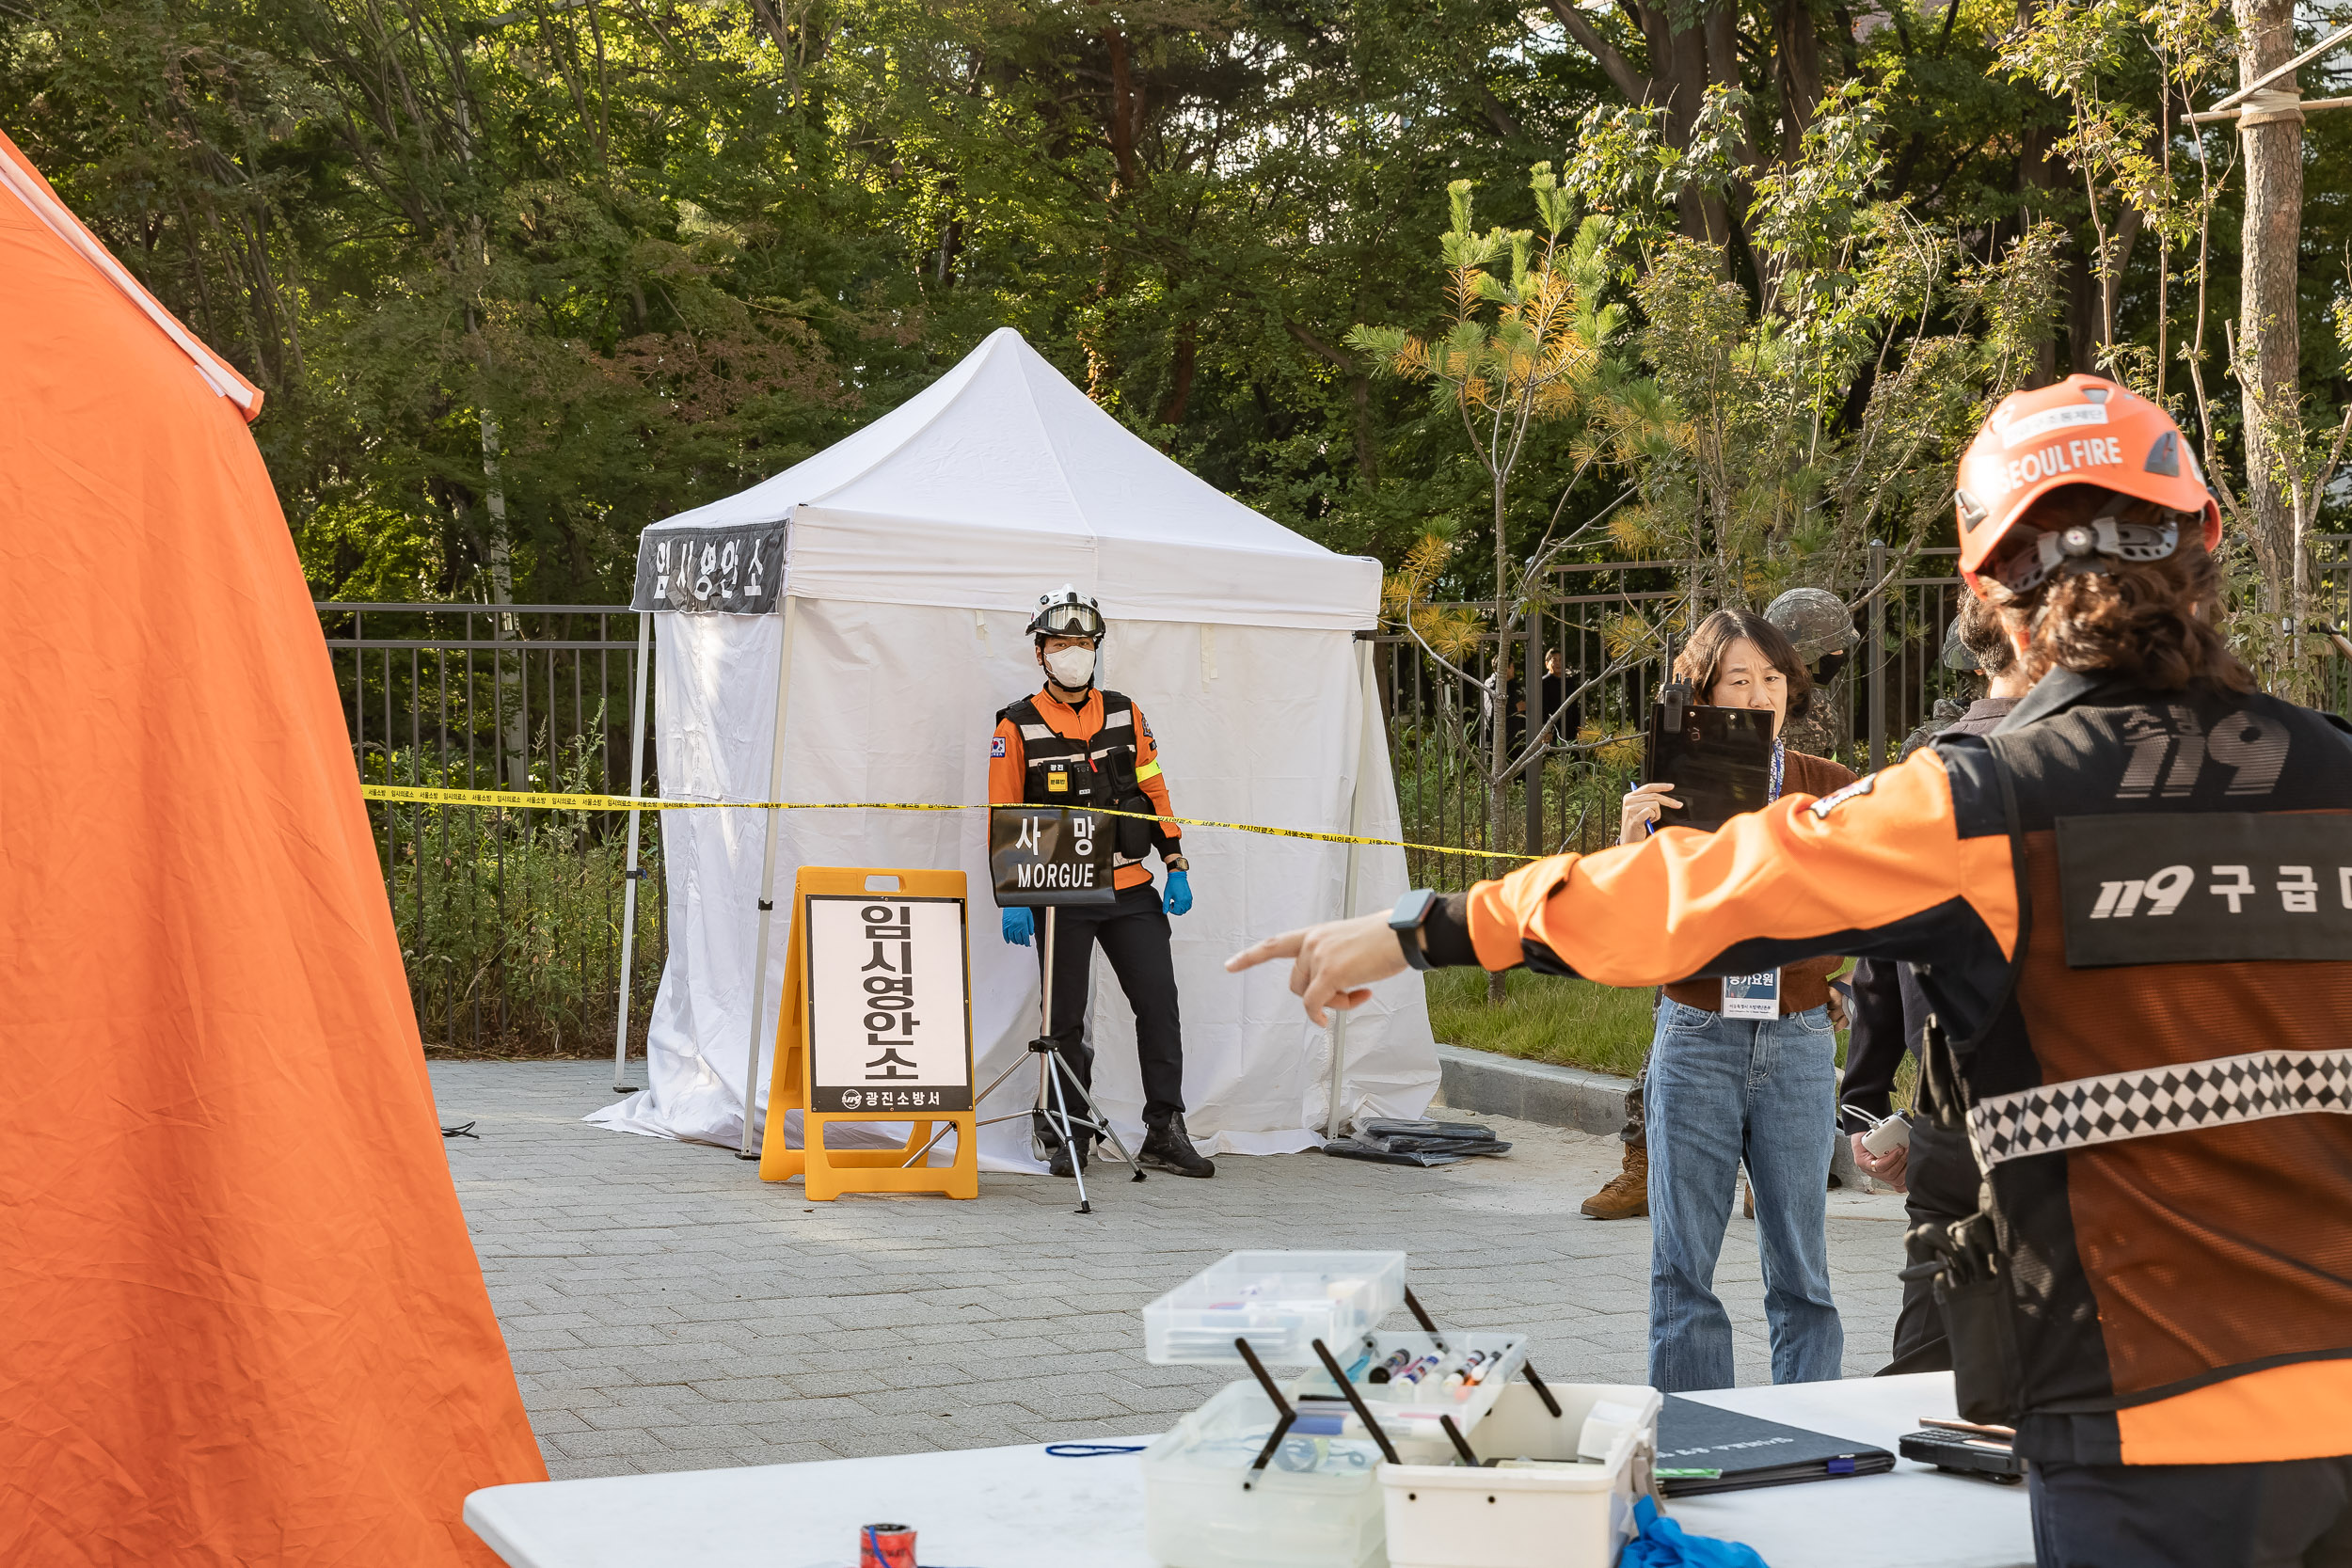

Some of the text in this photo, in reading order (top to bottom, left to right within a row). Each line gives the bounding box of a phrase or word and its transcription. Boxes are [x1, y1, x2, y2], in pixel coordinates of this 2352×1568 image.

[2000, 437, 2122, 494] SEOUL FIRE
[2115, 710, 2292, 799] 119
[368, 788, 387, 797] 서울소방
[390, 790, 415, 799] 임시의료소
[420, 791, 438, 800] 서울소방
[443, 792, 468, 800] 임시의료소
[471, 794, 492, 802] 서울소방
[497, 795, 521, 803] 임시의료소
[526, 796, 547, 805] 서울소방
[551, 797, 577, 805] 임시의료소
[581, 798, 602, 806] 서울소방
[1017, 863, 1094, 888] MORGUE
[861, 905, 921, 1080] 임시영안소
[866, 1091, 940, 1106] 광진소방서
